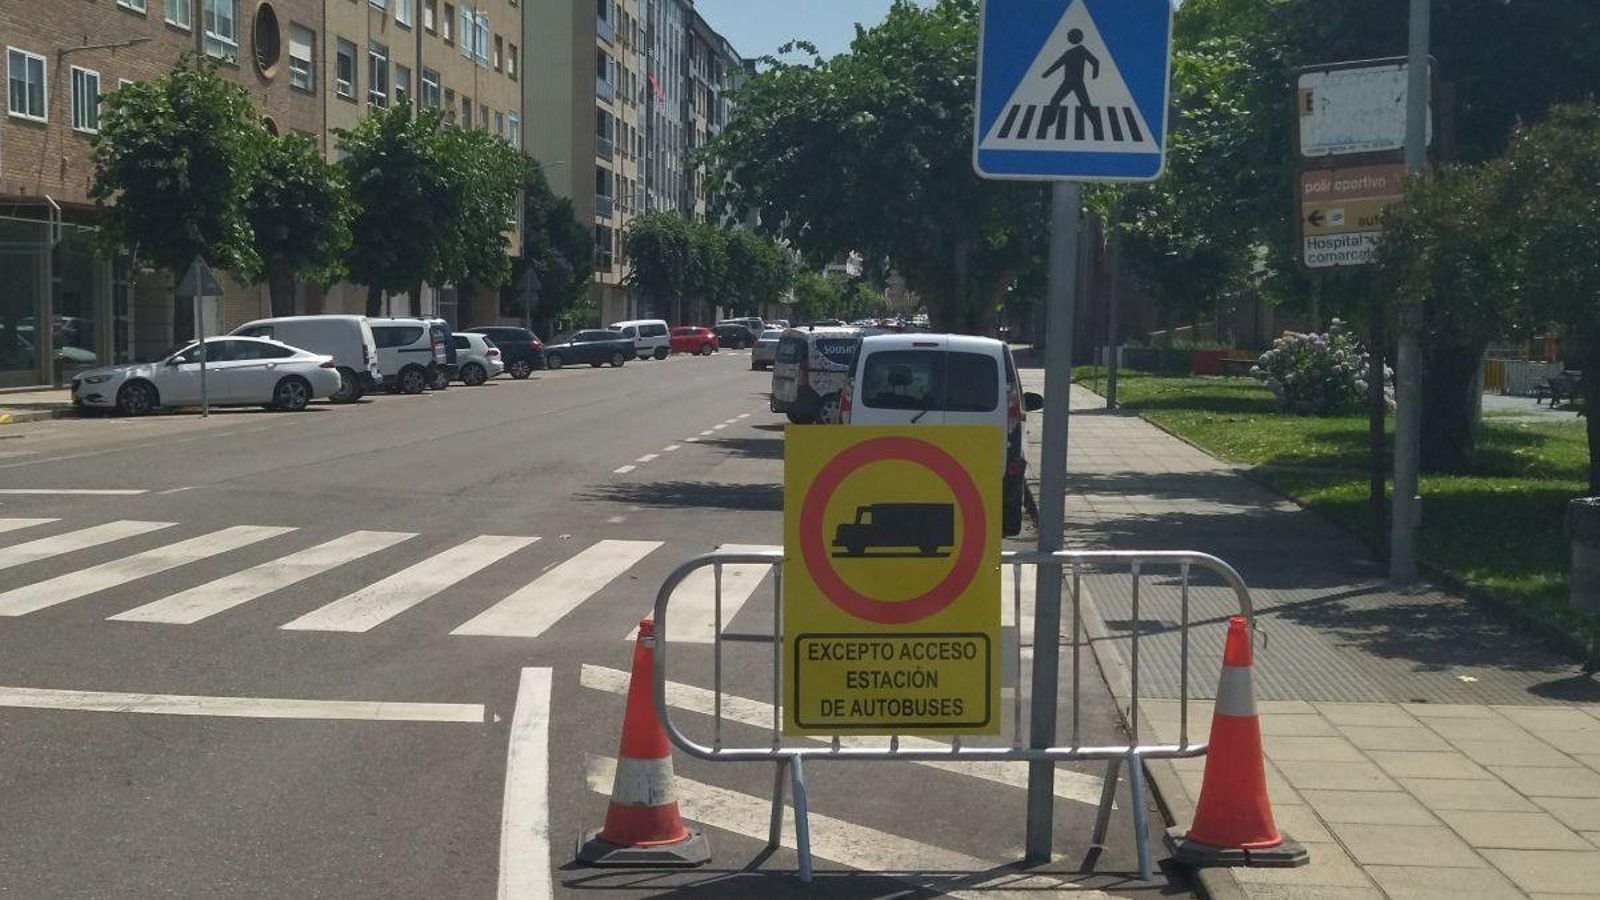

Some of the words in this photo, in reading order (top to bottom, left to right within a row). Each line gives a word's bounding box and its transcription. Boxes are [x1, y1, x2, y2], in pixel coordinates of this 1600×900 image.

[1307, 234, 1362, 250] Hospital
[808, 642, 894, 661] EXCEPTO
[900, 641, 977, 660] ACCESO
[846, 666, 938, 689] ESTACIÓN
[821, 699, 845, 717] DE
[850, 698, 964, 717] AUTOBUSES
